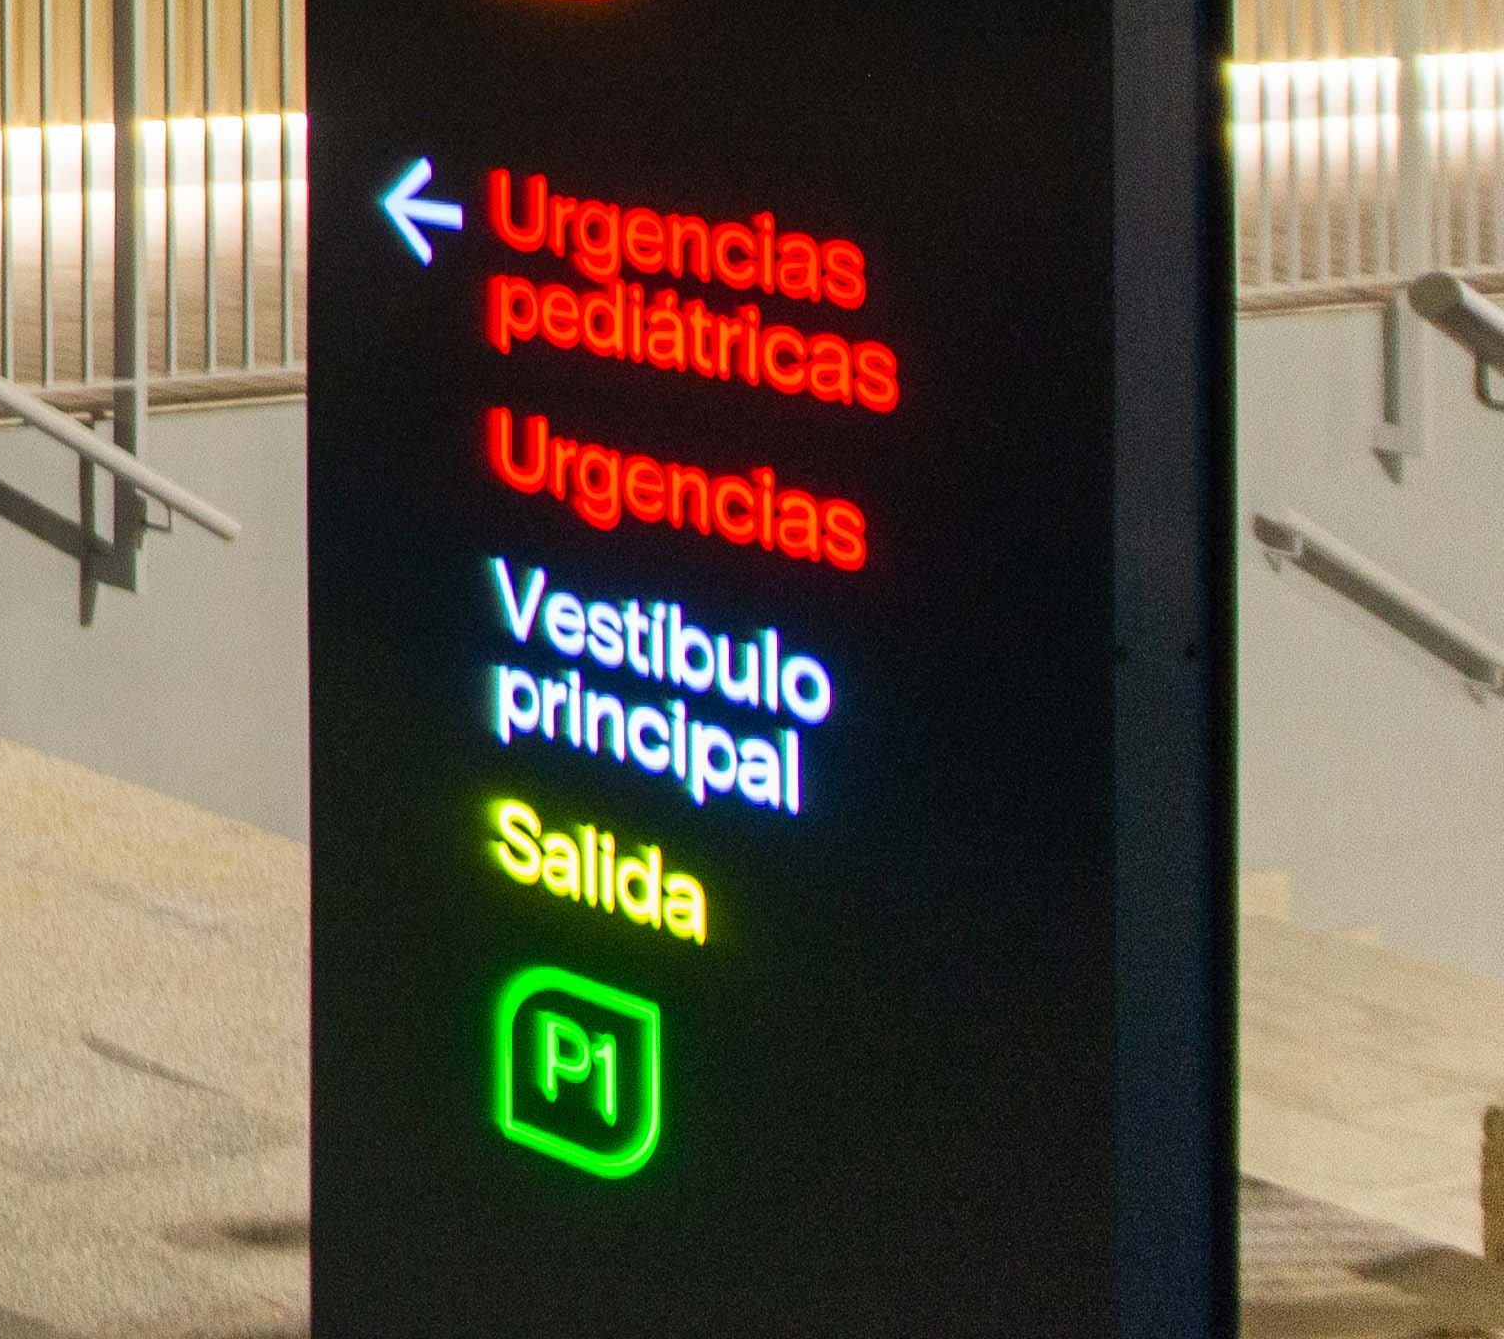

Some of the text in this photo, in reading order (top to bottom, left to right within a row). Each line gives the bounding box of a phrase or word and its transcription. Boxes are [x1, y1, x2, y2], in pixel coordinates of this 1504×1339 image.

[489, 169, 867, 309] Urgencias
[489, 274, 900, 412] pediátricas
[489, 407, 868, 570] Urgencias
[493, 663, 801, 813] principal
[490, 797, 708, 943] Salida
[538, 1012, 619, 1124] P1
